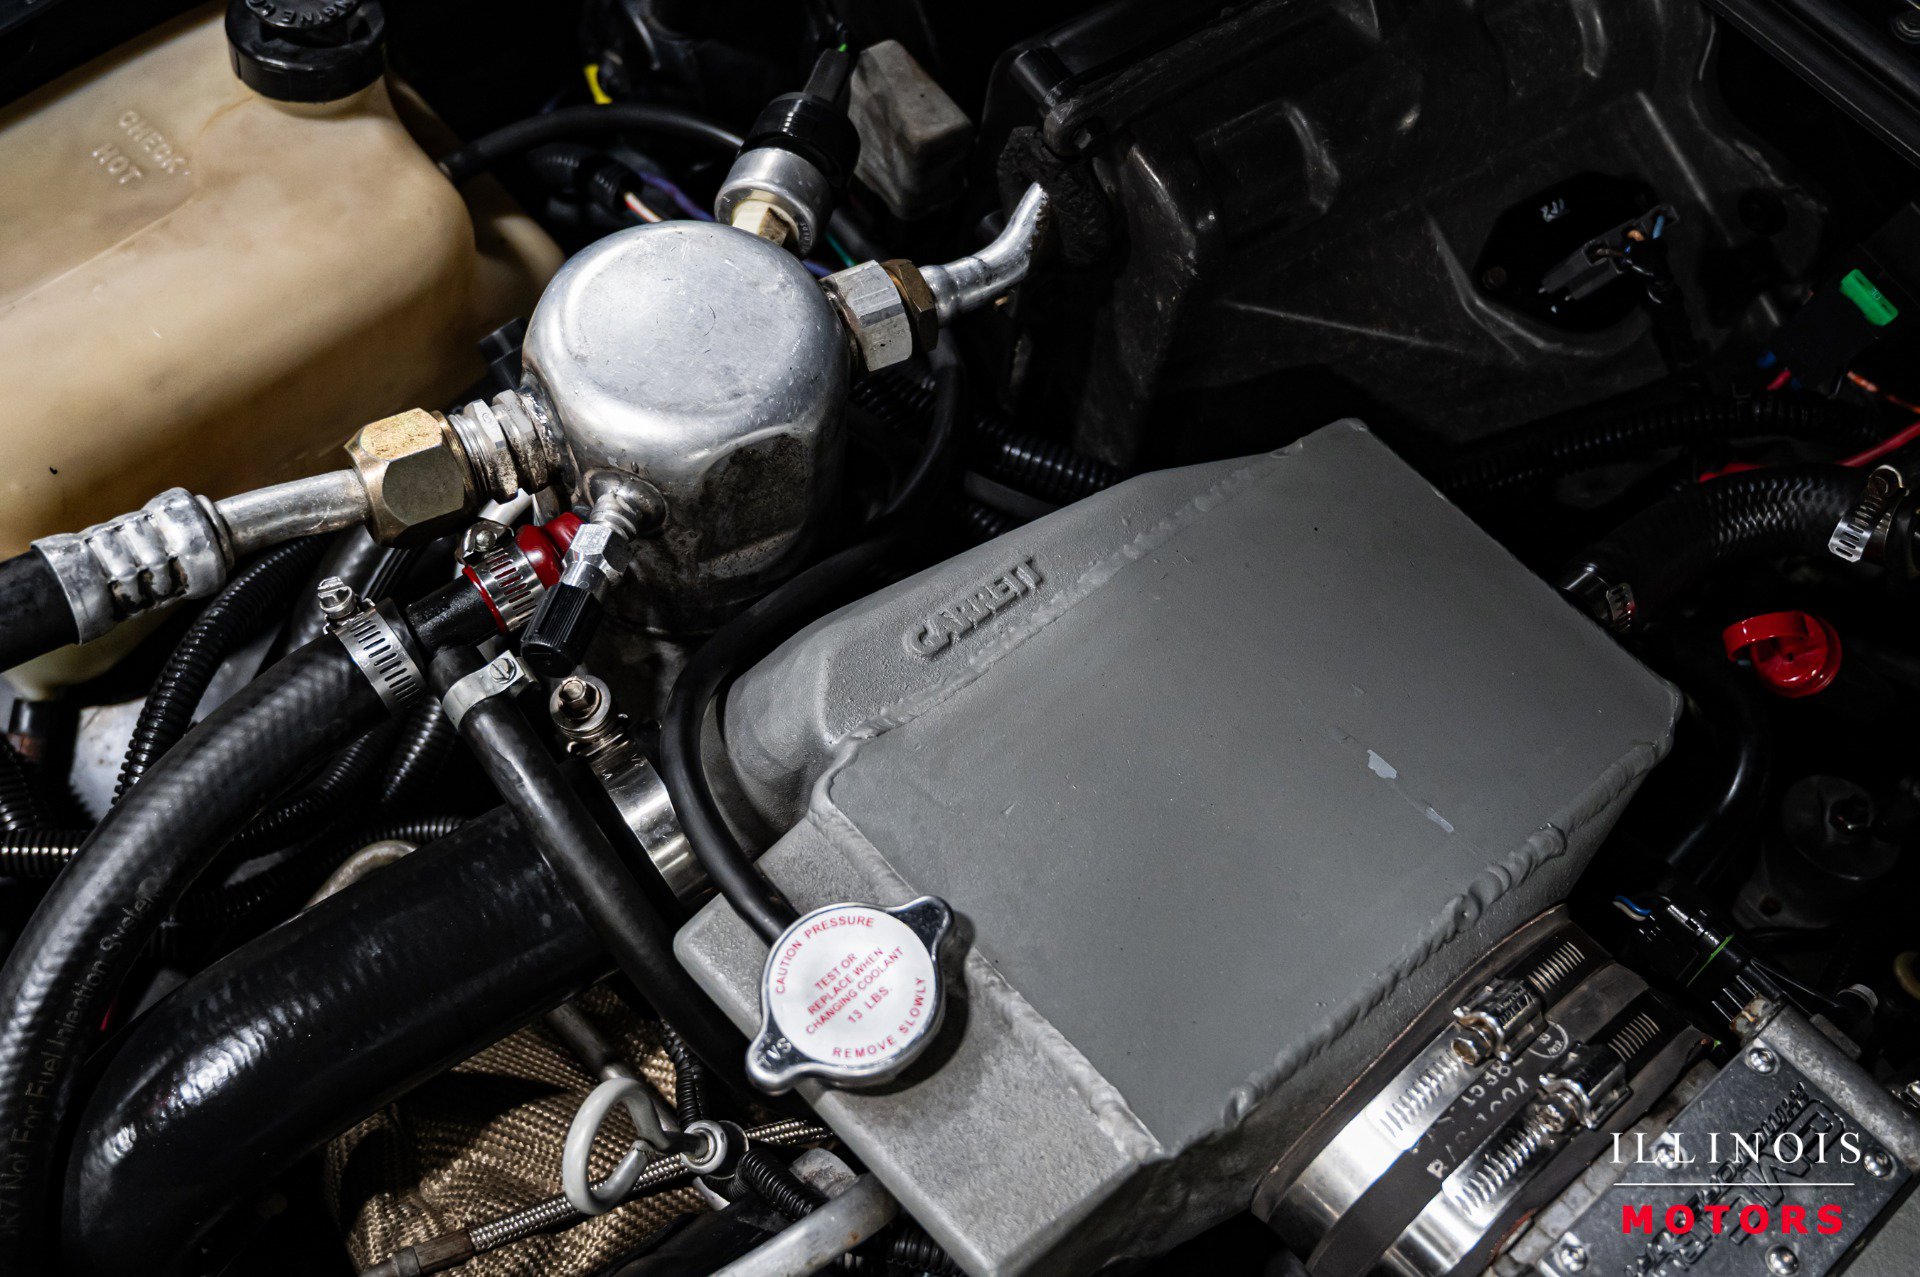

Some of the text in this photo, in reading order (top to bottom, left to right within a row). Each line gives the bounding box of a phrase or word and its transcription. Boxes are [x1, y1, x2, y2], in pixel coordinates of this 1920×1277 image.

[91, 143, 141, 184] HOT
[119, 110, 184, 175] CHECK
[775, 915, 875, 994] CAUTION PRESSURE
[807, 948, 884, 1016] REPLACE WHEN
[814, 952, 858, 991] TEST OR
[47, 960, 112, 1047] Injection
[805, 946, 904, 1035] CHANGING COOLANT
[832, 977, 926, 1058] REMOVE SLOWLY
[848, 1009, 863, 1023] 13
[24, 1051, 62, 1098] Fuel
[11, 1104, 43, 1143] For
